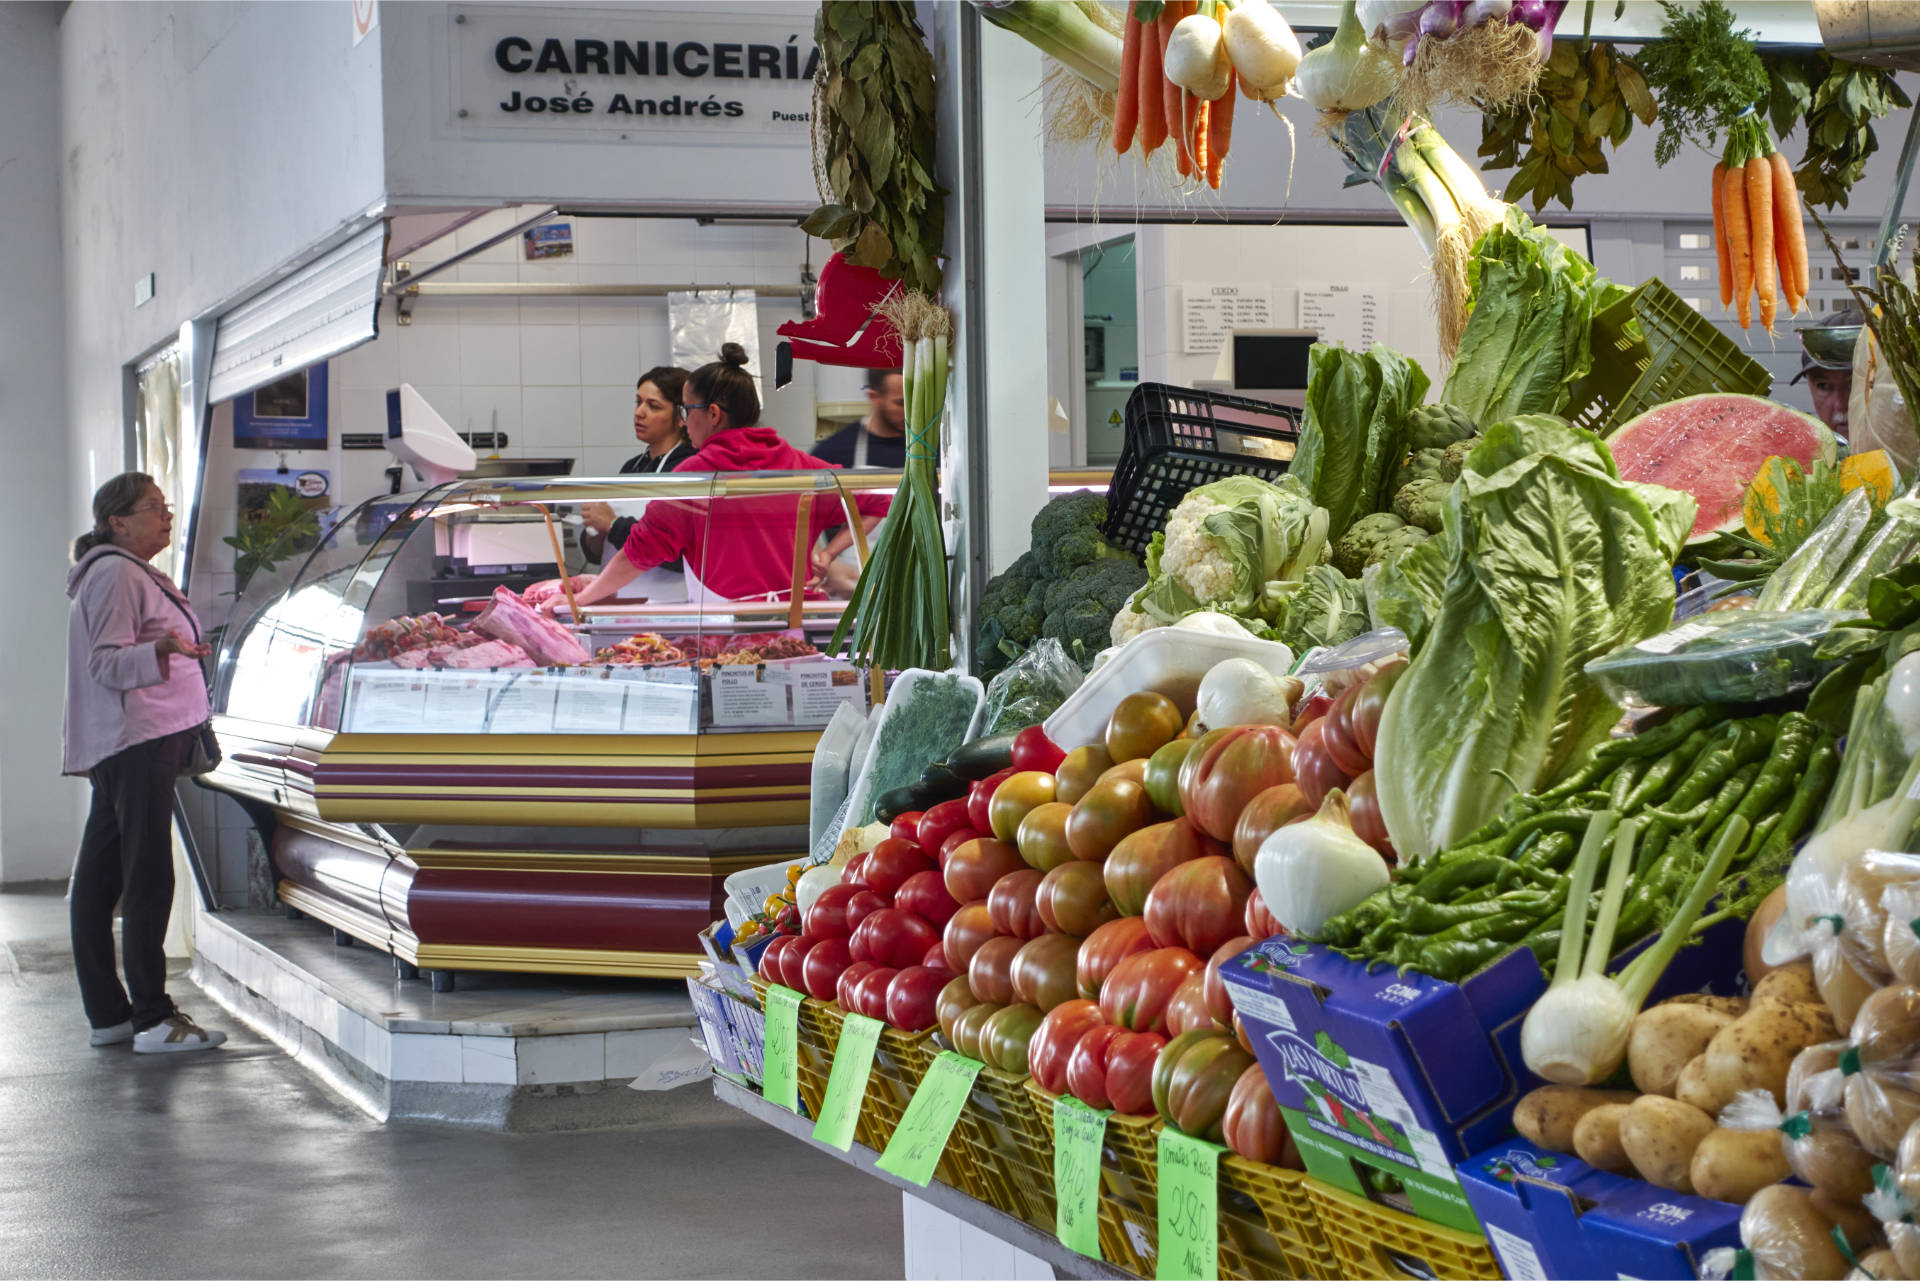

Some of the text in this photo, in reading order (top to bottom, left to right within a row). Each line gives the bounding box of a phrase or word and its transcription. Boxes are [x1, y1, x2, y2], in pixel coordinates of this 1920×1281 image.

[500, 91, 744, 117] José Andrés
[772, 111, 810, 122] Puest
[1281, 1043, 1309, 1071] LAS
[1303, 1048, 1367, 1105] VIRTUD
[1169, 1184, 1208, 1241] 2'80
